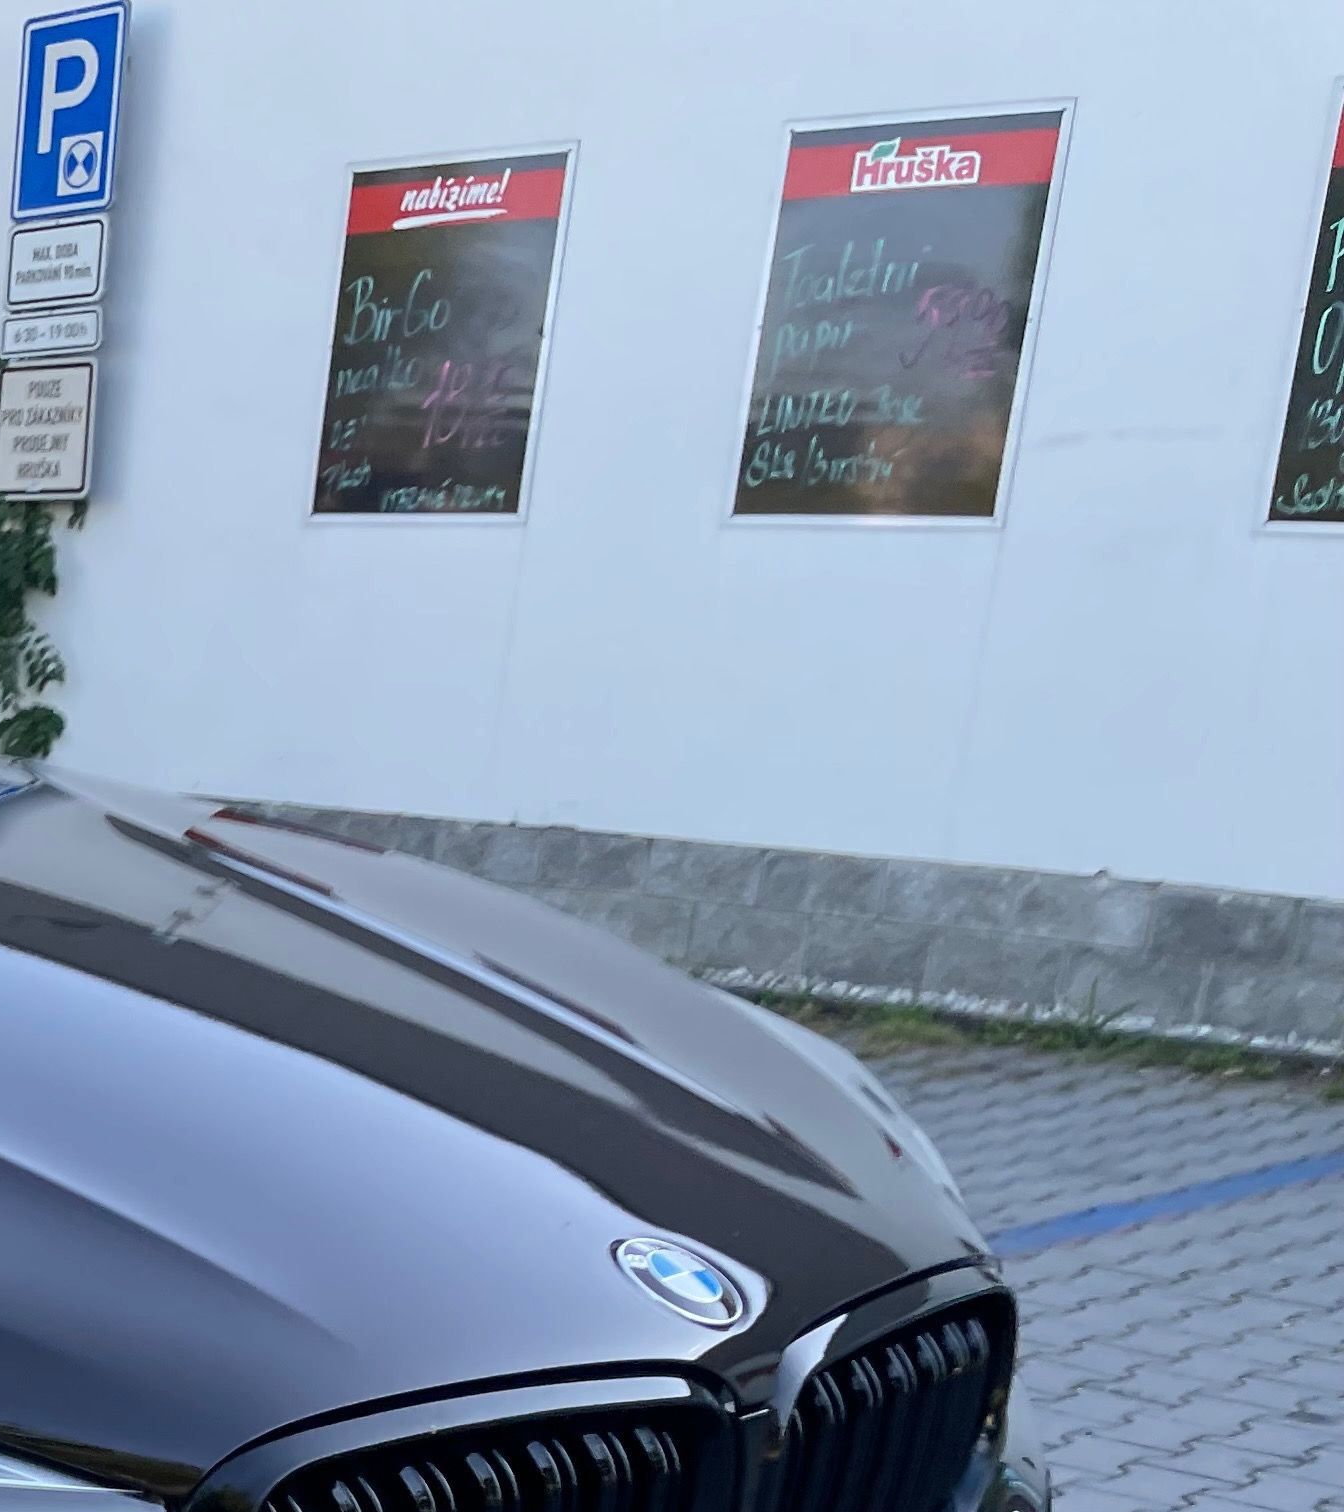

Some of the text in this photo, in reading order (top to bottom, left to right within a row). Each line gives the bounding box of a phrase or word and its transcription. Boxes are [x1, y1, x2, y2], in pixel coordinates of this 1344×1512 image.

[37, 38, 100, 154] P
[400, 168, 512, 212] nabízíme!
[855, 149, 976, 187] Hruška
